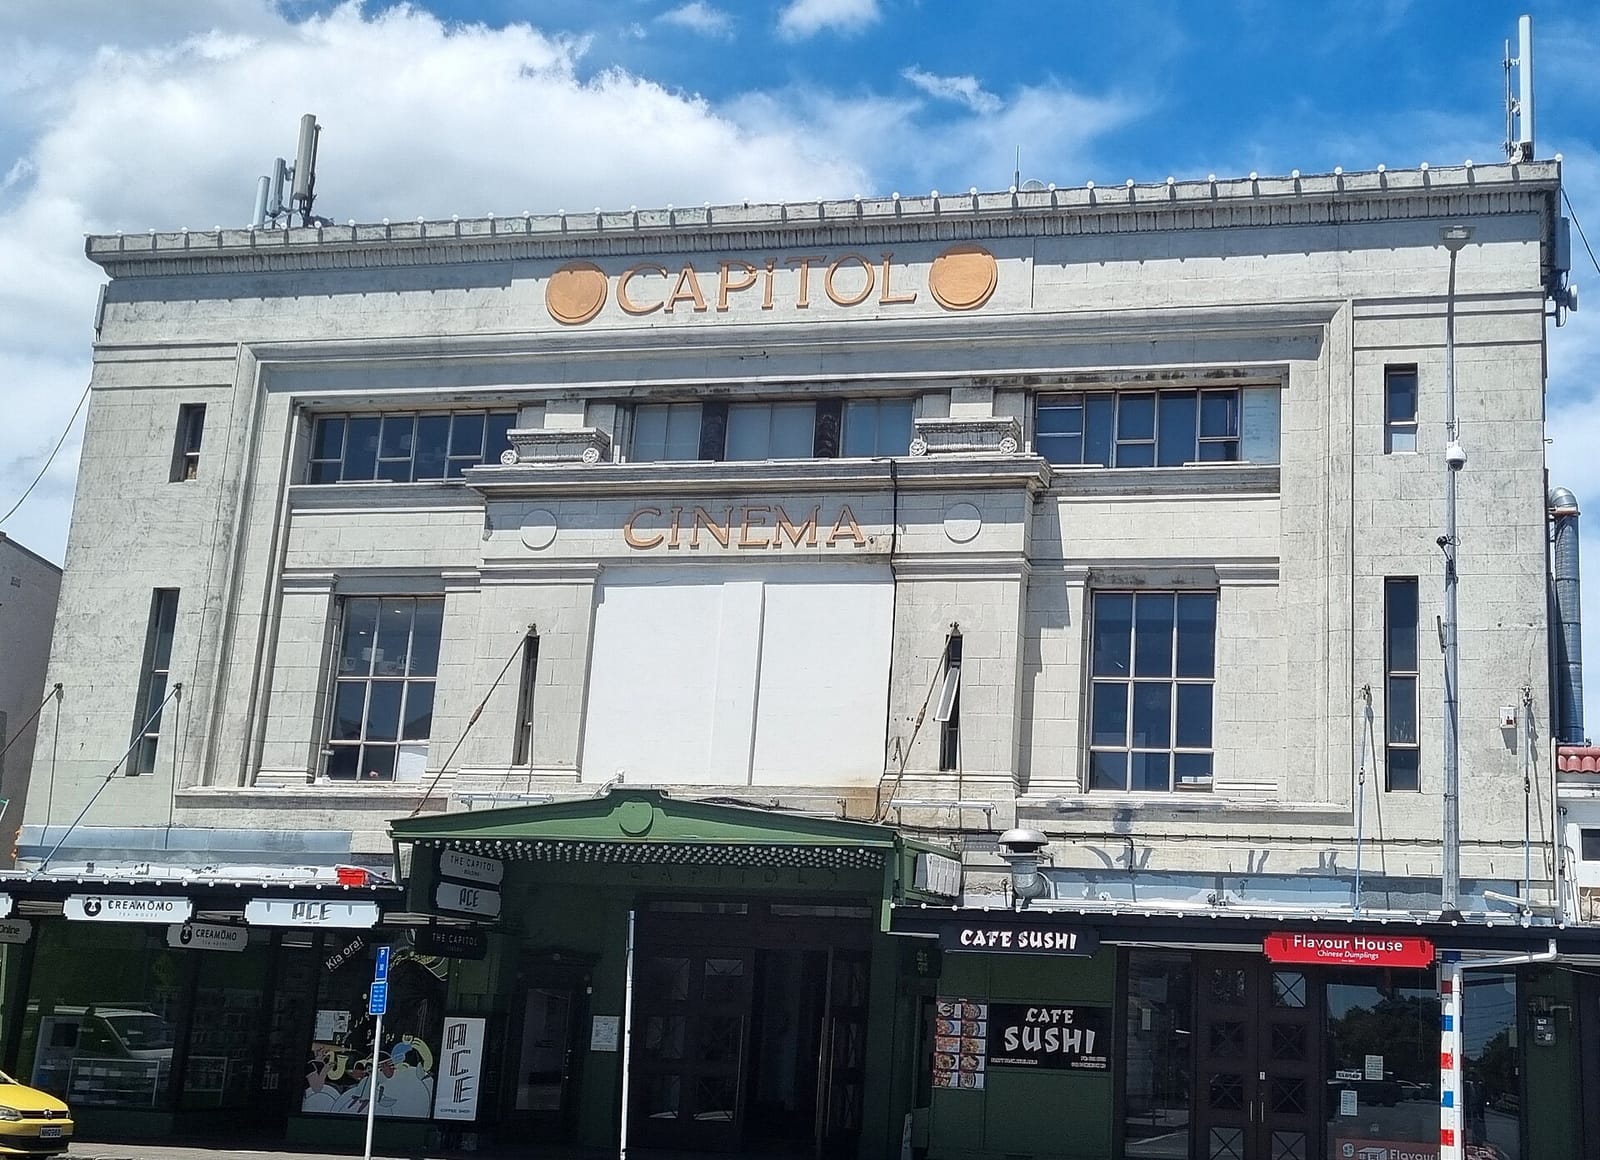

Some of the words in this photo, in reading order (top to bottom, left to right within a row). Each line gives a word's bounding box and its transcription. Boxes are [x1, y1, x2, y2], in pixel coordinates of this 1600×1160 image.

[616, 251, 917, 316] CAPITOL
[622, 504, 866, 551] CINEMA
[450, 855, 463, 866] THE
[466, 858, 495, 872] CAPITOL
[459, 888, 480, 908] ACE
[291, 901, 332, 921] ACE
[432, 932, 446, 943] THE
[448, 934, 479, 946] CAPITOL
[960, 929, 1012, 948] CAFE
[1018, 930, 1077, 950] SUSHI
[1294, 934, 1350, 950] Flavour
[1354, 936, 1403, 952] House
[325, 953, 344, 972] Kia
[343, 935, 365, 956] ora!
[1317, 949, 1344, 958] Chinese
[1344, 951, 1379, 960] Dumplings
[1025, 1008, 1074, 1024] CAFE
[1004, 1026, 1096, 1054] SUSHI
